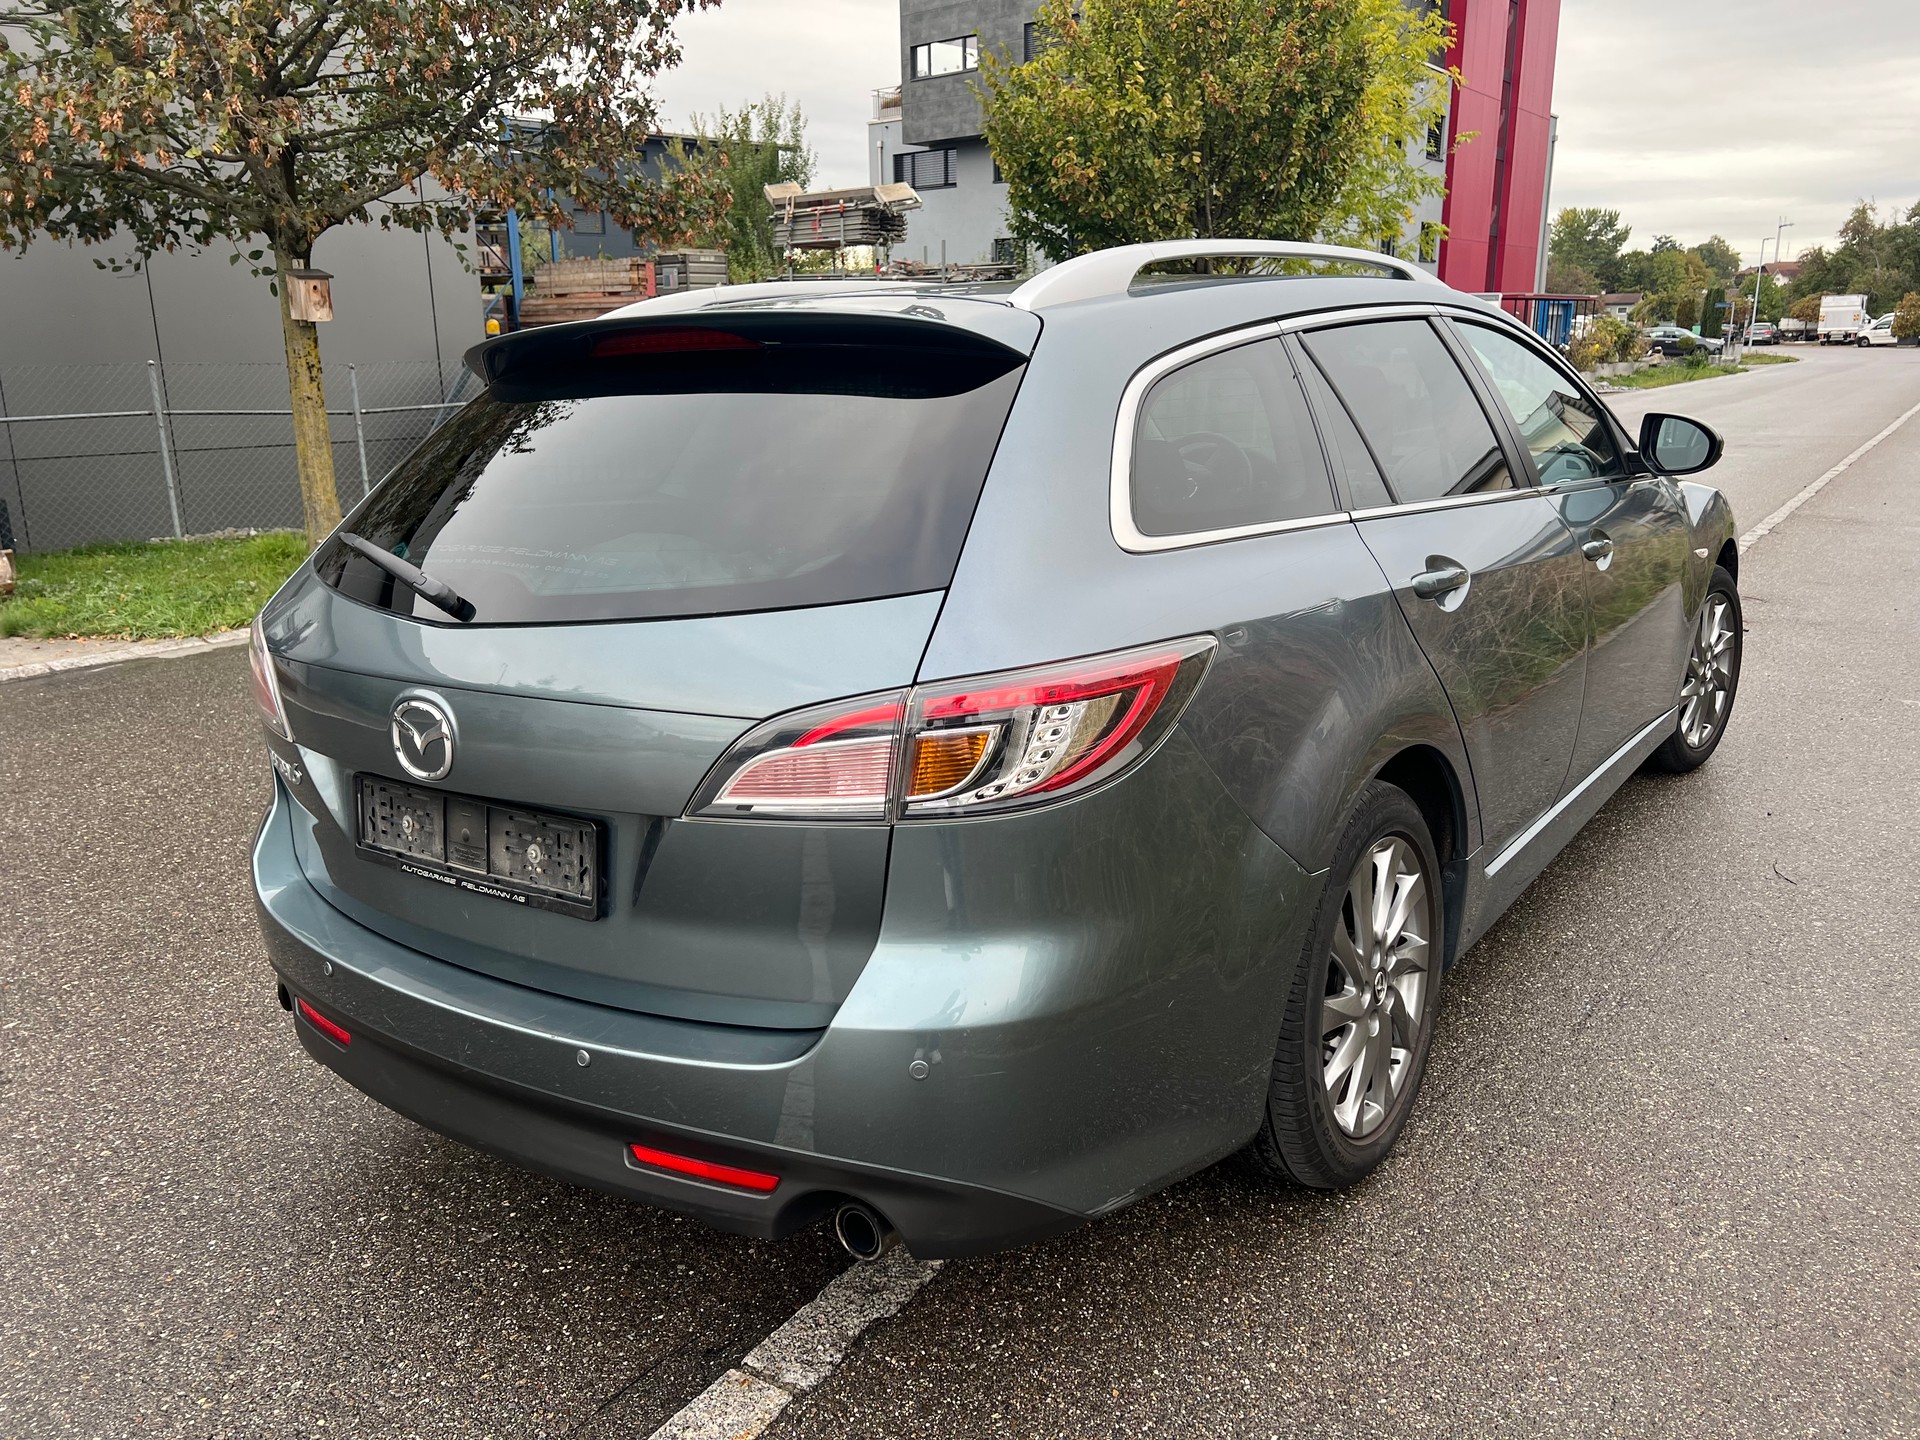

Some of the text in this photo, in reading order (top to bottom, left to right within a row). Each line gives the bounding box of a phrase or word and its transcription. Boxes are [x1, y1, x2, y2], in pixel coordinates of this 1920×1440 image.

[401, 865, 526, 903] AUTOGARAGE FELDMANN AG
